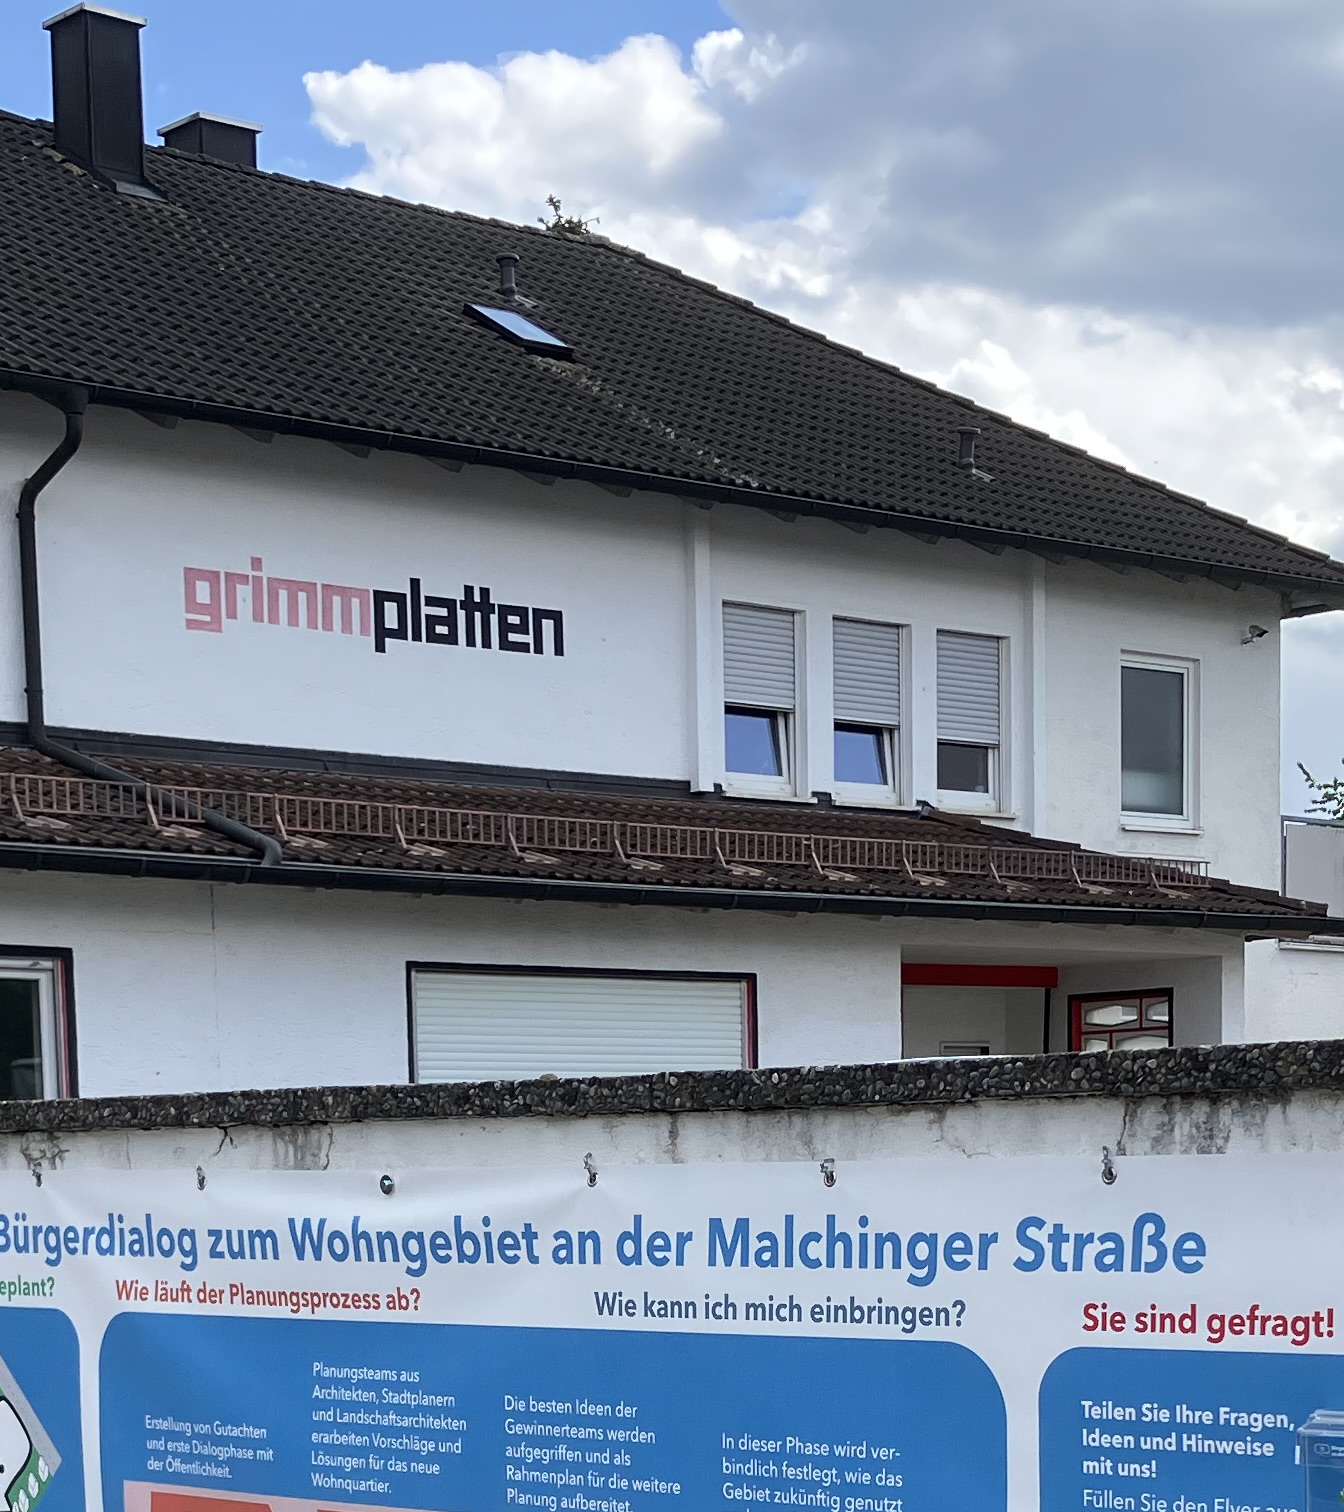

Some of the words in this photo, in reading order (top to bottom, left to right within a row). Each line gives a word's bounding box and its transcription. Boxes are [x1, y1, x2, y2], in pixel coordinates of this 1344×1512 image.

[183, 556, 565, 656] grimmplatten
[207, 1229, 279, 1260] zum
[288, 1215, 539, 1277] Wohngebiet
[552, 1230, 601, 1264] an
[616, 1214, 693, 1266] der
[708, 1214, 998, 1287] Malchinger
[1013, 1212, 1206, 1273] Straße
[116, 1279, 148, 1301] Wie
[155, 1280, 192, 1303] läuft
[197, 1281, 224, 1304] der
[229, 1282, 380, 1314] Planungsprozess
[386, 1287, 420, 1311] ab?
[594, 1291, 636, 1317] Wie
[644, 1291, 696, 1318] kann
[705, 1293, 736, 1320] ich
[745, 1294, 802, 1322] mich
[810, 1296, 965, 1333] einbringen?
[1082, 1302, 1126, 1332] Sie
[1134, 1303, 1196, 1333] sind
[1207, 1304, 1333, 1346] gefragt!
[313, 1362, 397, 1382] Planungsteams
[400, 1371, 419, 1382] aus
[312, 1385, 379, 1404] Architekten,
[382, 1388, 454, 1408] Stadtplanern
[505, 1395, 525, 1411] Die
[530, 1396, 572, 1413] besten
[576, 1399, 611, 1416] Ideen
[615, 1401, 637, 1417] der
[1081, 1400, 1136, 1420] Teilen
[1141, 1403, 1170, 1422] Sie
[1176, 1404, 1213, 1424] Ihre
[1219, 1407, 1295, 1432] Fragen,
[505, 1418, 603, 1440] Gewinnerteams
[607, 1426, 655, 1443] werden
[1083, 1428, 1134, 1448] Ideen
[1140, 1432, 1176, 1450] und
[1182, 1433, 1274, 1456] Hinweise
[506, 1442, 581, 1464] aufgegriffen
[586, 1448, 609, 1464] und
[613, 1449, 630, 1466] als
[722, 1433, 734, 1449] In
[739, 1433, 782, 1452] dieser
[786, 1436, 829, 1455] Phase
[833, 1441, 866, 1458] wird
[871, 1447, 900, 1459] ver-
[507, 1465, 584, 1488] Rahmenplan
[587, 1470, 605, 1487] für
[608, 1473, 628, 1489] die
[632, 1477, 680, 1494] weitere
[723, 1456, 777, 1477] bindlich
[782, 1461, 840, 1486] festlegt,
[845, 1468, 871, 1484] wie
[875, 1468, 902, 1487] das
[1083, 1456, 1113, 1475] mit
[1118, 1460, 1156, 1477] uns!
[507, 1488, 556, 1511] Planung
[723, 1482, 770, 1502] Gebiet
[774, 1487, 840, 1512] zukünftig
[1084, 1489, 1134, 1510] Füllen
[1140, 1493, 1167, 1512] Sie
